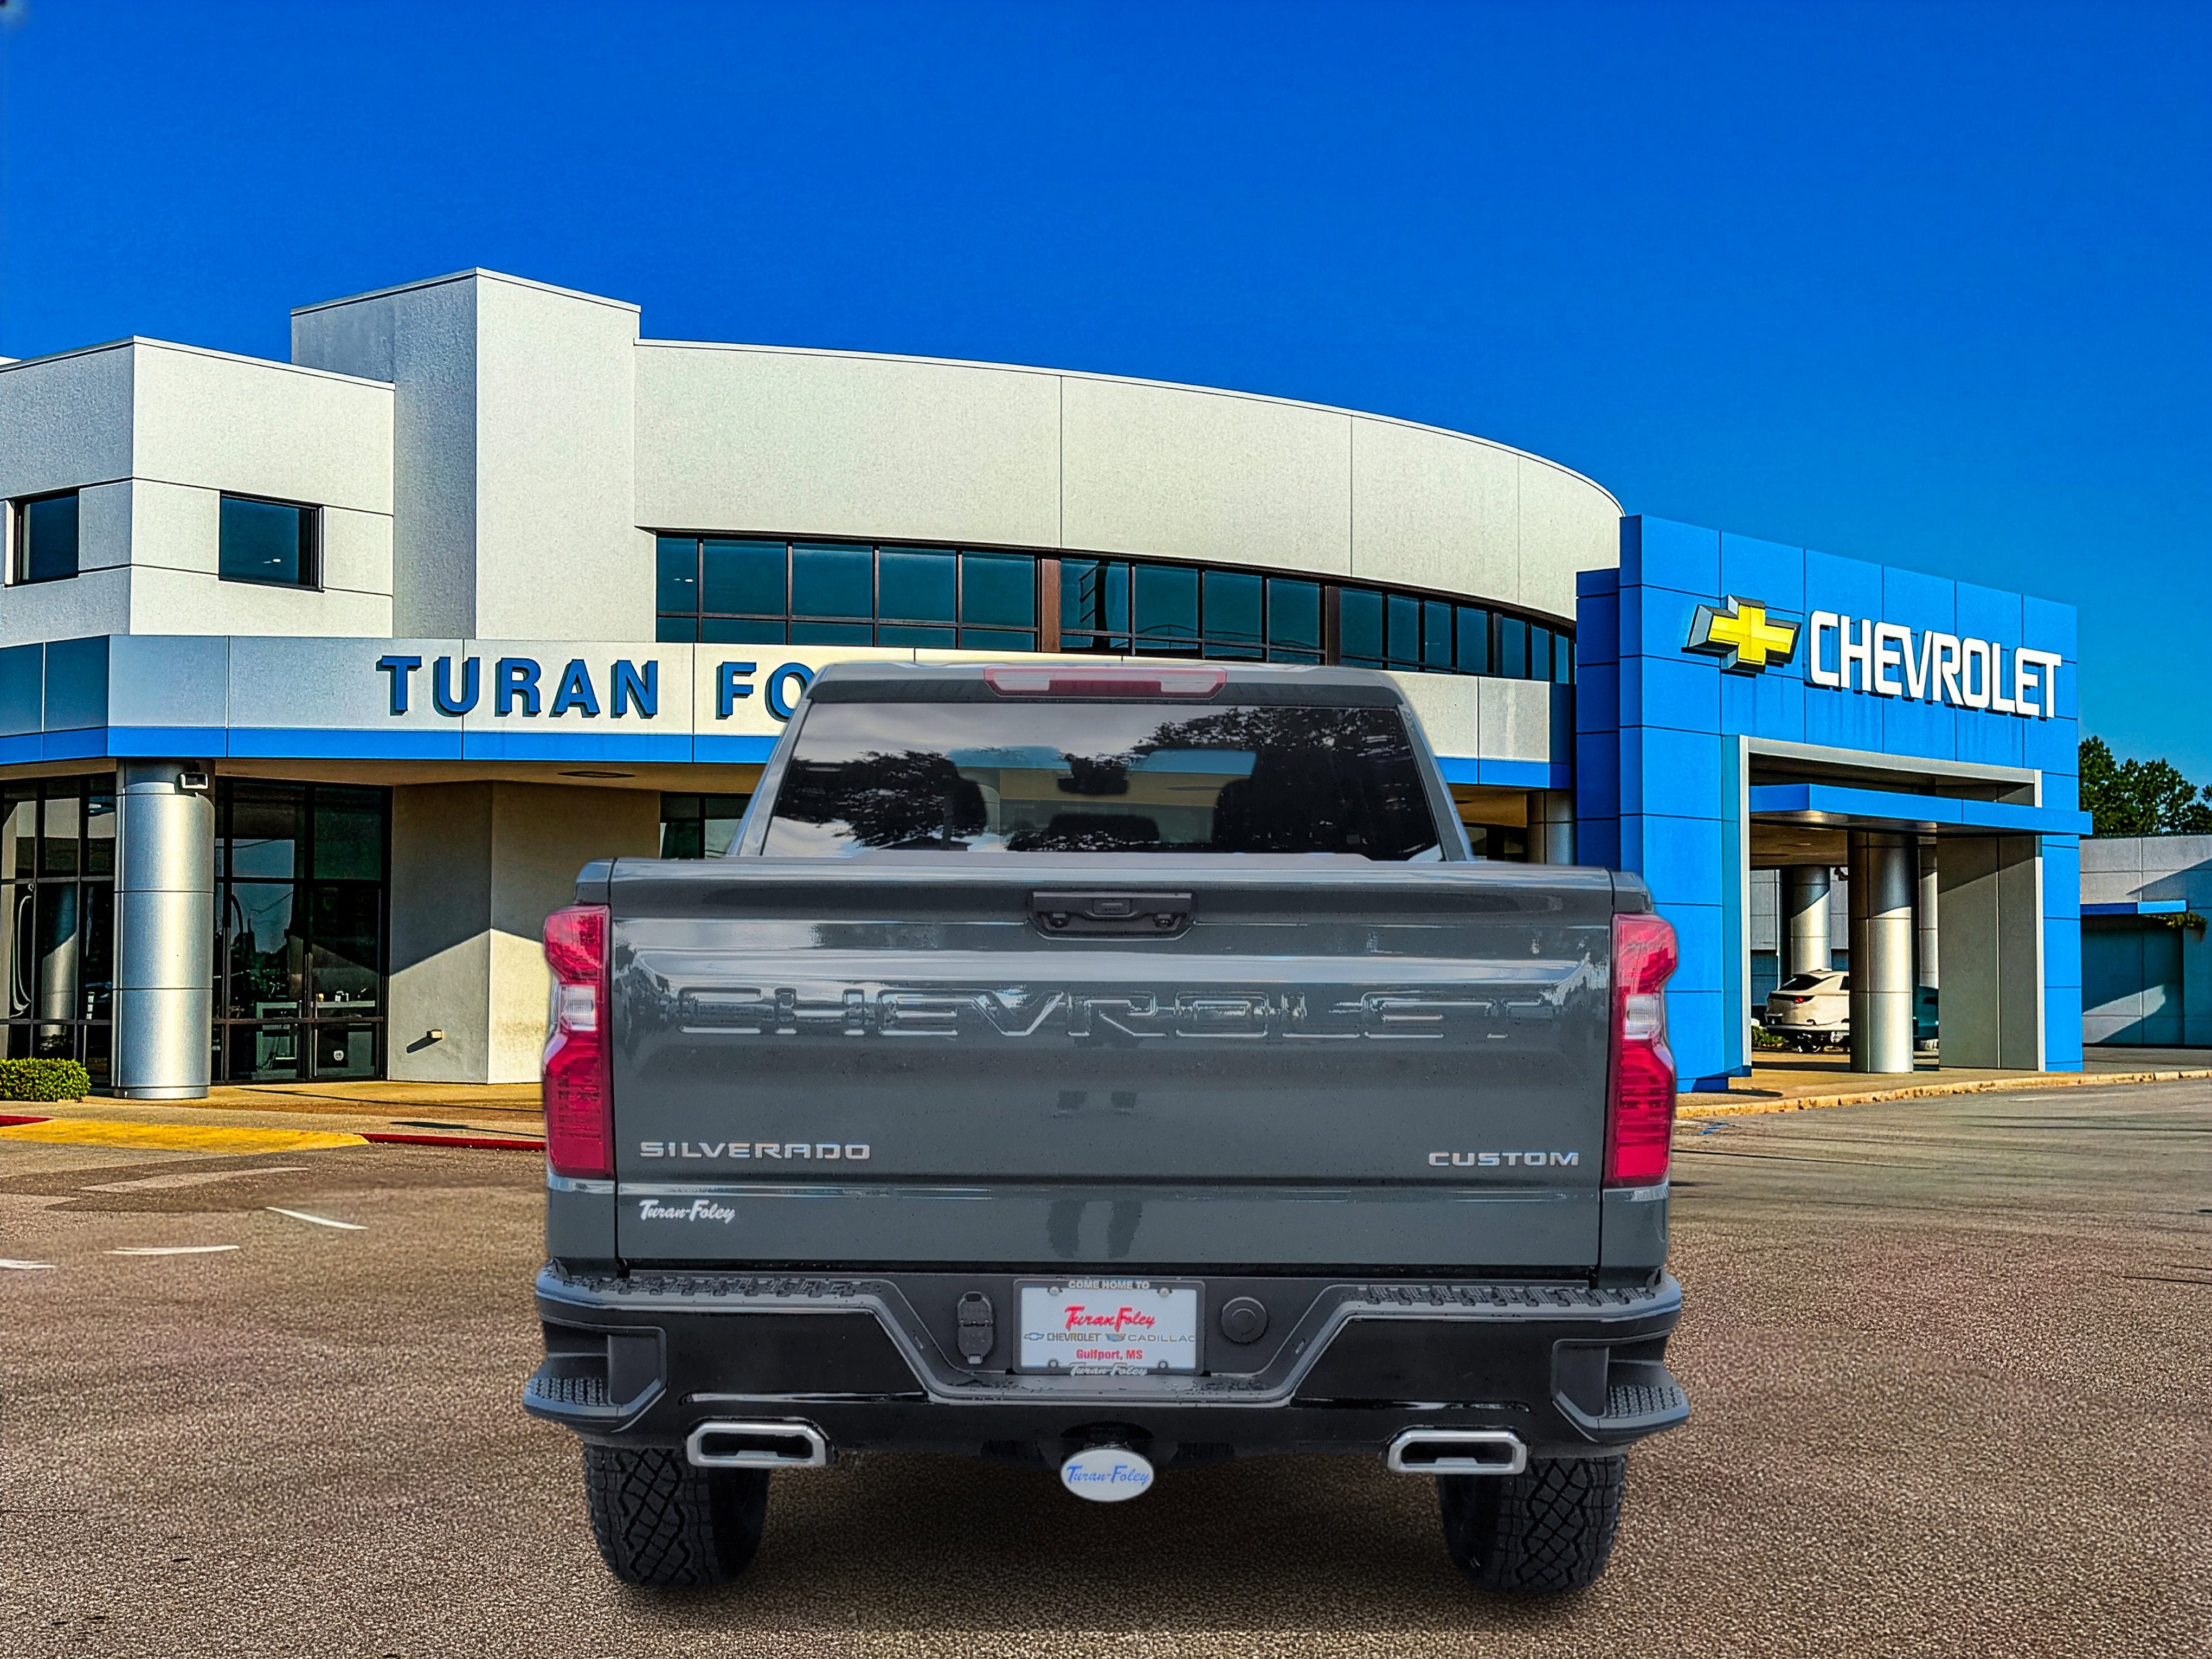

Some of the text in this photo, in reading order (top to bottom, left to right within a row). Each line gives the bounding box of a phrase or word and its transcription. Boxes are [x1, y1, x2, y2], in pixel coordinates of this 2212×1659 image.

[1809, 610, 2062, 718] CHEVROLET
[376, 655, 659, 719] TURAN
[678, 987, 1553, 1039] CHEVROLET
[640, 1141, 871, 1160] SILVERADO
[1428, 1151, 1579, 1167] CUSTOM
[1068, 1280, 1150, 1290] COME HOME TO
[1046, 1333, 1196, 1343] CHEVROLET CADILLAC
[1076, 1348, 1143, 1361] Gulfport, MS
